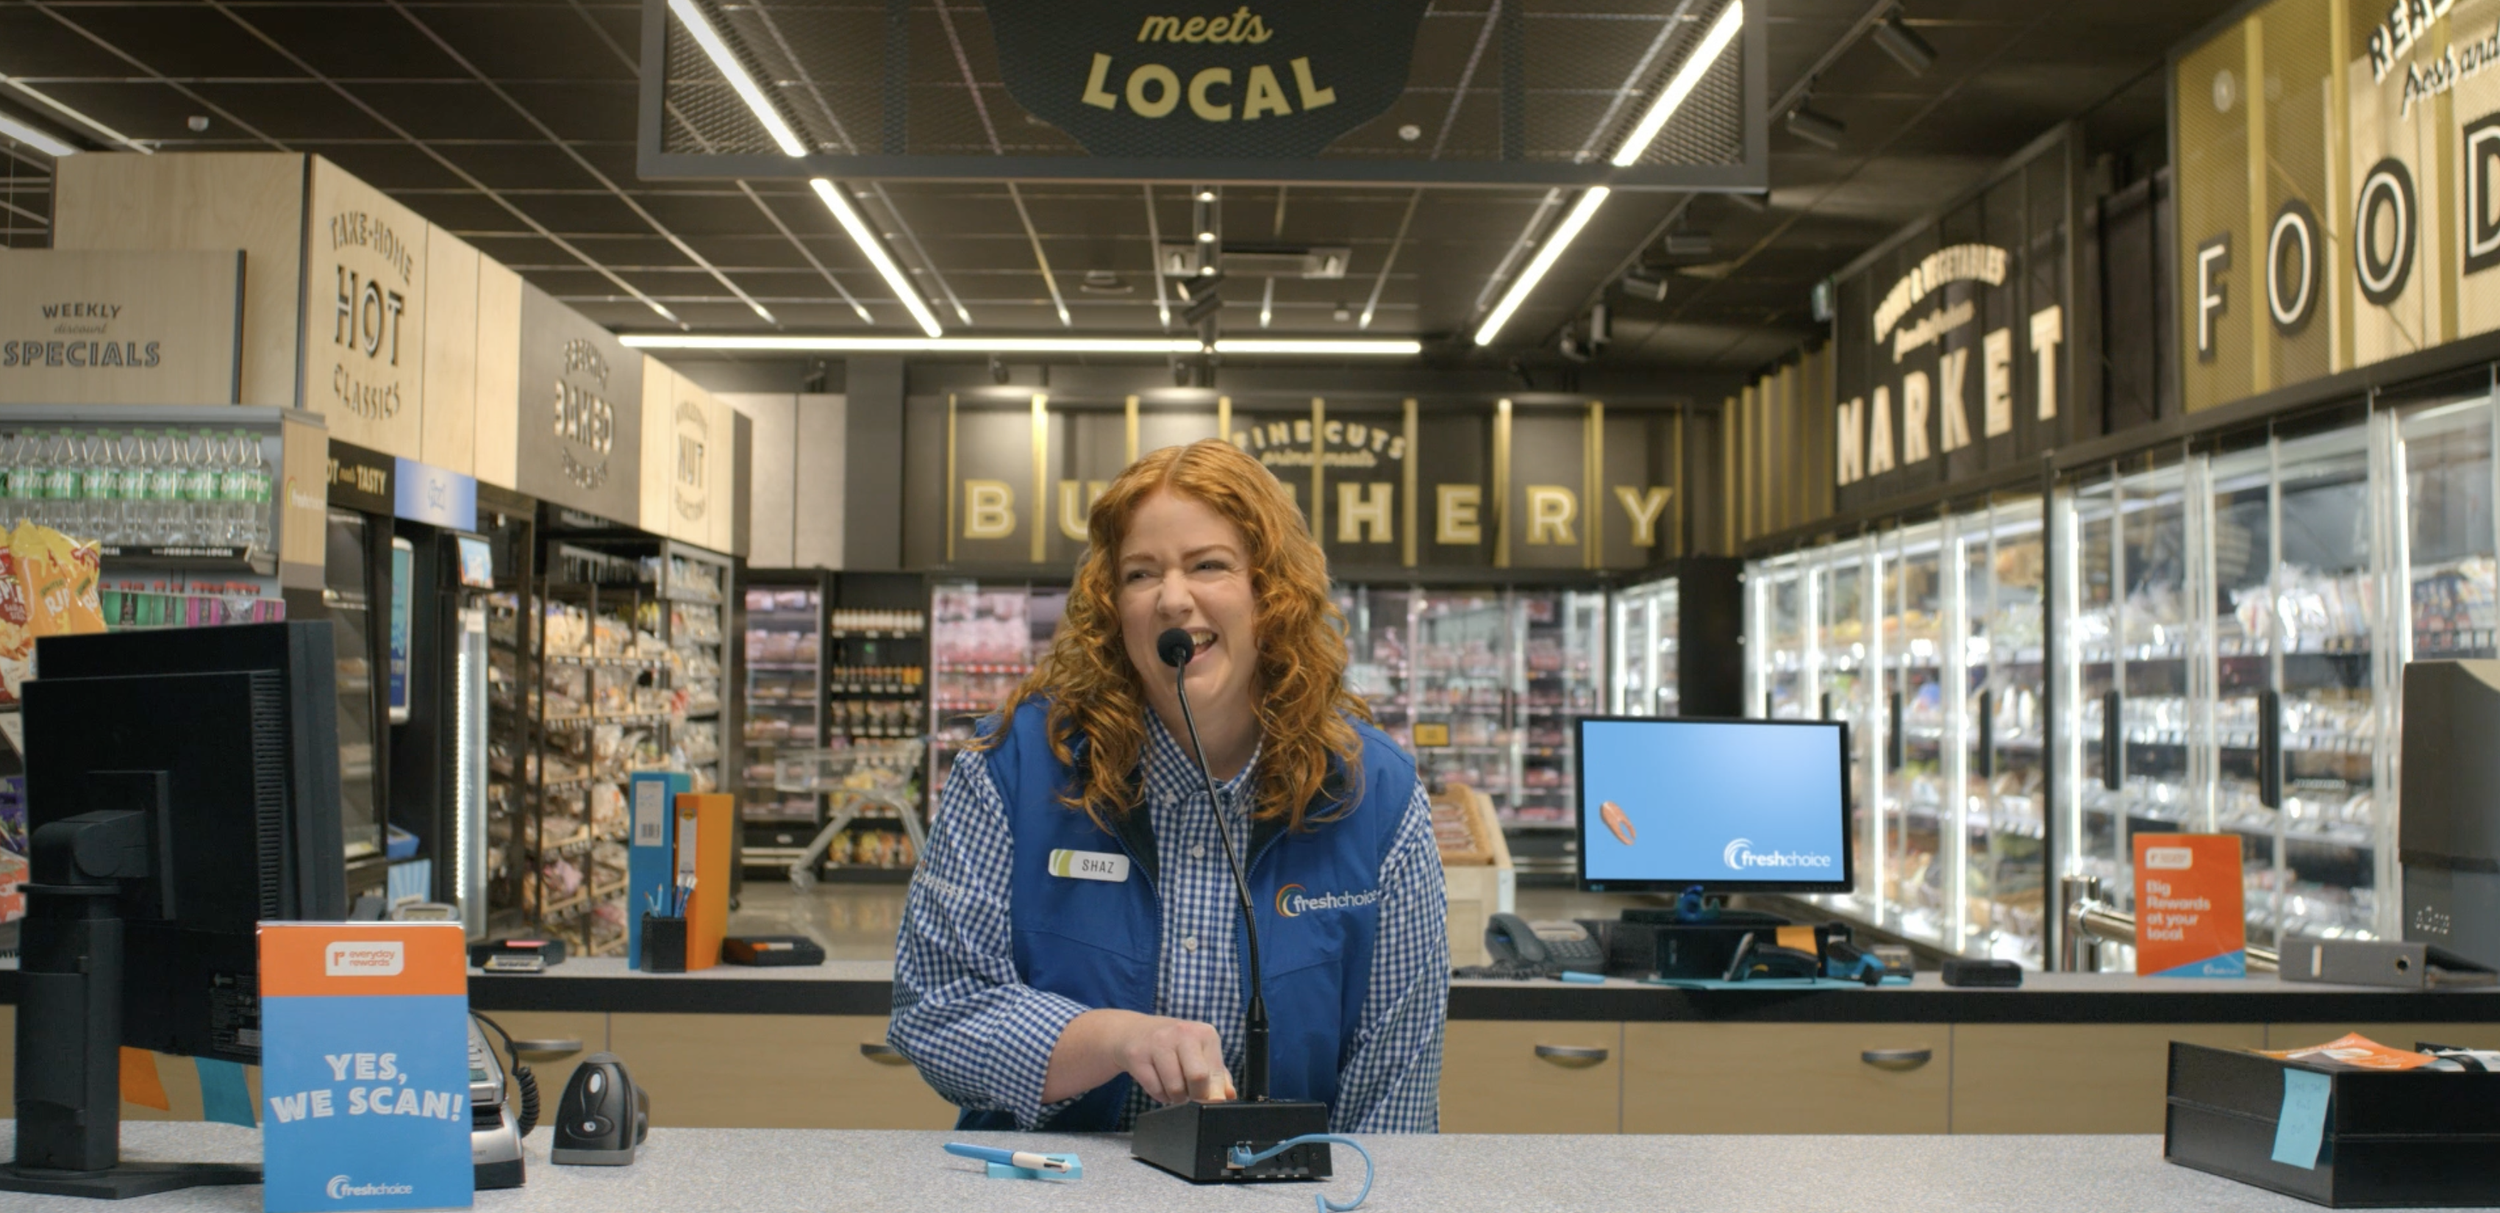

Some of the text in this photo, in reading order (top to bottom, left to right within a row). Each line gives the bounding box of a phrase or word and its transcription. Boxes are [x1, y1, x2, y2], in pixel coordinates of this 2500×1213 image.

[1137, 6, 1273, 44] meets
[2368, 0, 2456, 86] REA
[1081, 52, 1337, 122] LOCAL
[2401, 42, 2461, 122] fresh
[330, 211, 413, 287] TAKE-HOME
[42, 303, 122, 319] WEEKLY
[334, 263, 405, 367] HOT
[54, 323, 107, 334] discount
[3, 340, 161, 368] SPECIALS
[334, 363, 400, 421] CLASSICS
[1837, 304, 2063, 487] MARKET
[554, 378, 615, 456] BAKED
[1232, 420, 1406, 460] FINE CUTS
[327, 459, 340, 485] OT
[356, 464, 388, 495] TASTY
[677, 433, 704, 490] NUT
[963, 478, 1674, 547] BUHERY
[1082, 858, 1115, 874] SHAZ
[1741, 851, 1831, 867] freshchoice
[1293, 889, 1378, 912] freshchoice
[2146, 879, 2171, 897] Big
[2146, 895, 2211, 911] Rewards
[2146, 913, 2199, 928] at your
[2146, 926, 2184, 941] local
[349, 950, 395, 960] everyday
[349, 959, 390, 967] rewards
[325, 1053, 407, 1085] YES,
[270, 1087, 464, 1123] WE SCAN!
[340, 1182, 413, 1198] freshchoice
